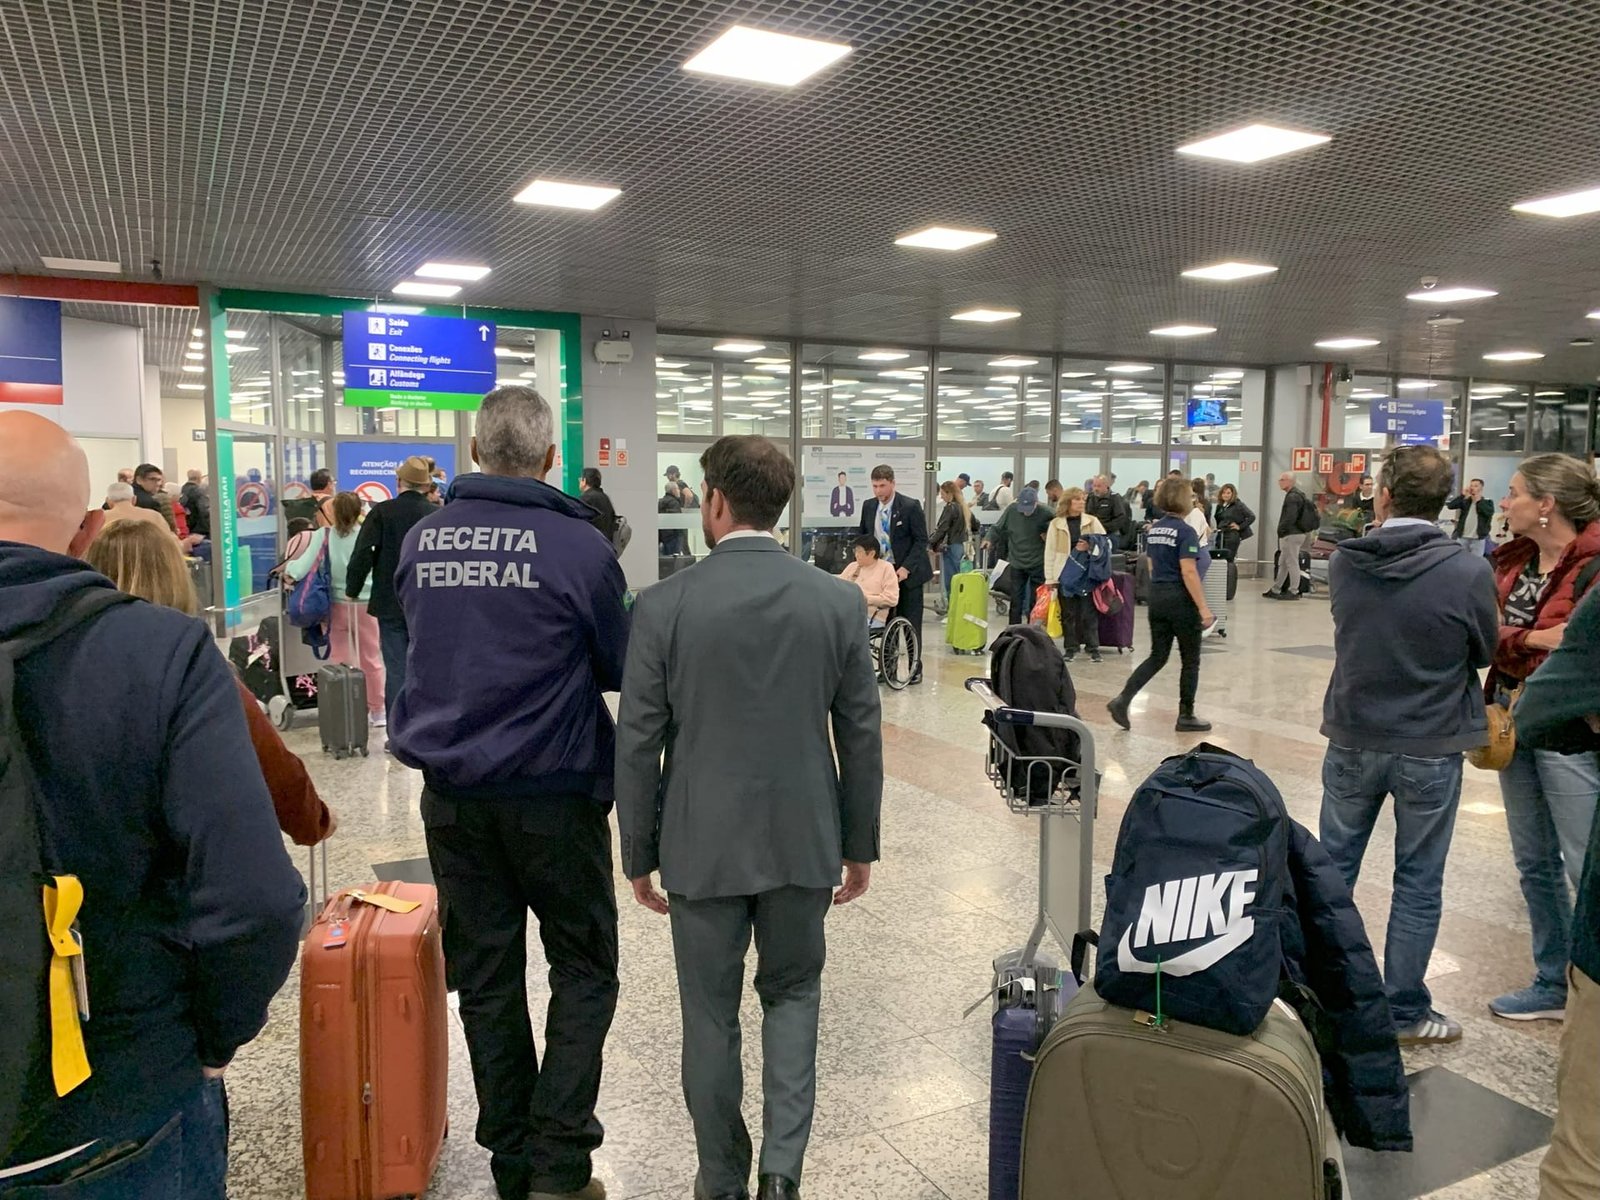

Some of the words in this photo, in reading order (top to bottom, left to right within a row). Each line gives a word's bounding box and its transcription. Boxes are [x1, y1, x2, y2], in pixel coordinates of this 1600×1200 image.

[389, 328, 403, 336] Exit
[389, 354, 428, 364] Connecting
[429, 355, 451, 365] flights
[390, 380, 419, 388] Customs
[1296, 451, 1310, 469] H
[1321, 456, 1331, 471] H
[418, 527, 538, 553] RECEITA
[416, 561, 540, 588] FEDERAL
[1134, 869, 1258, 948] NIKE
